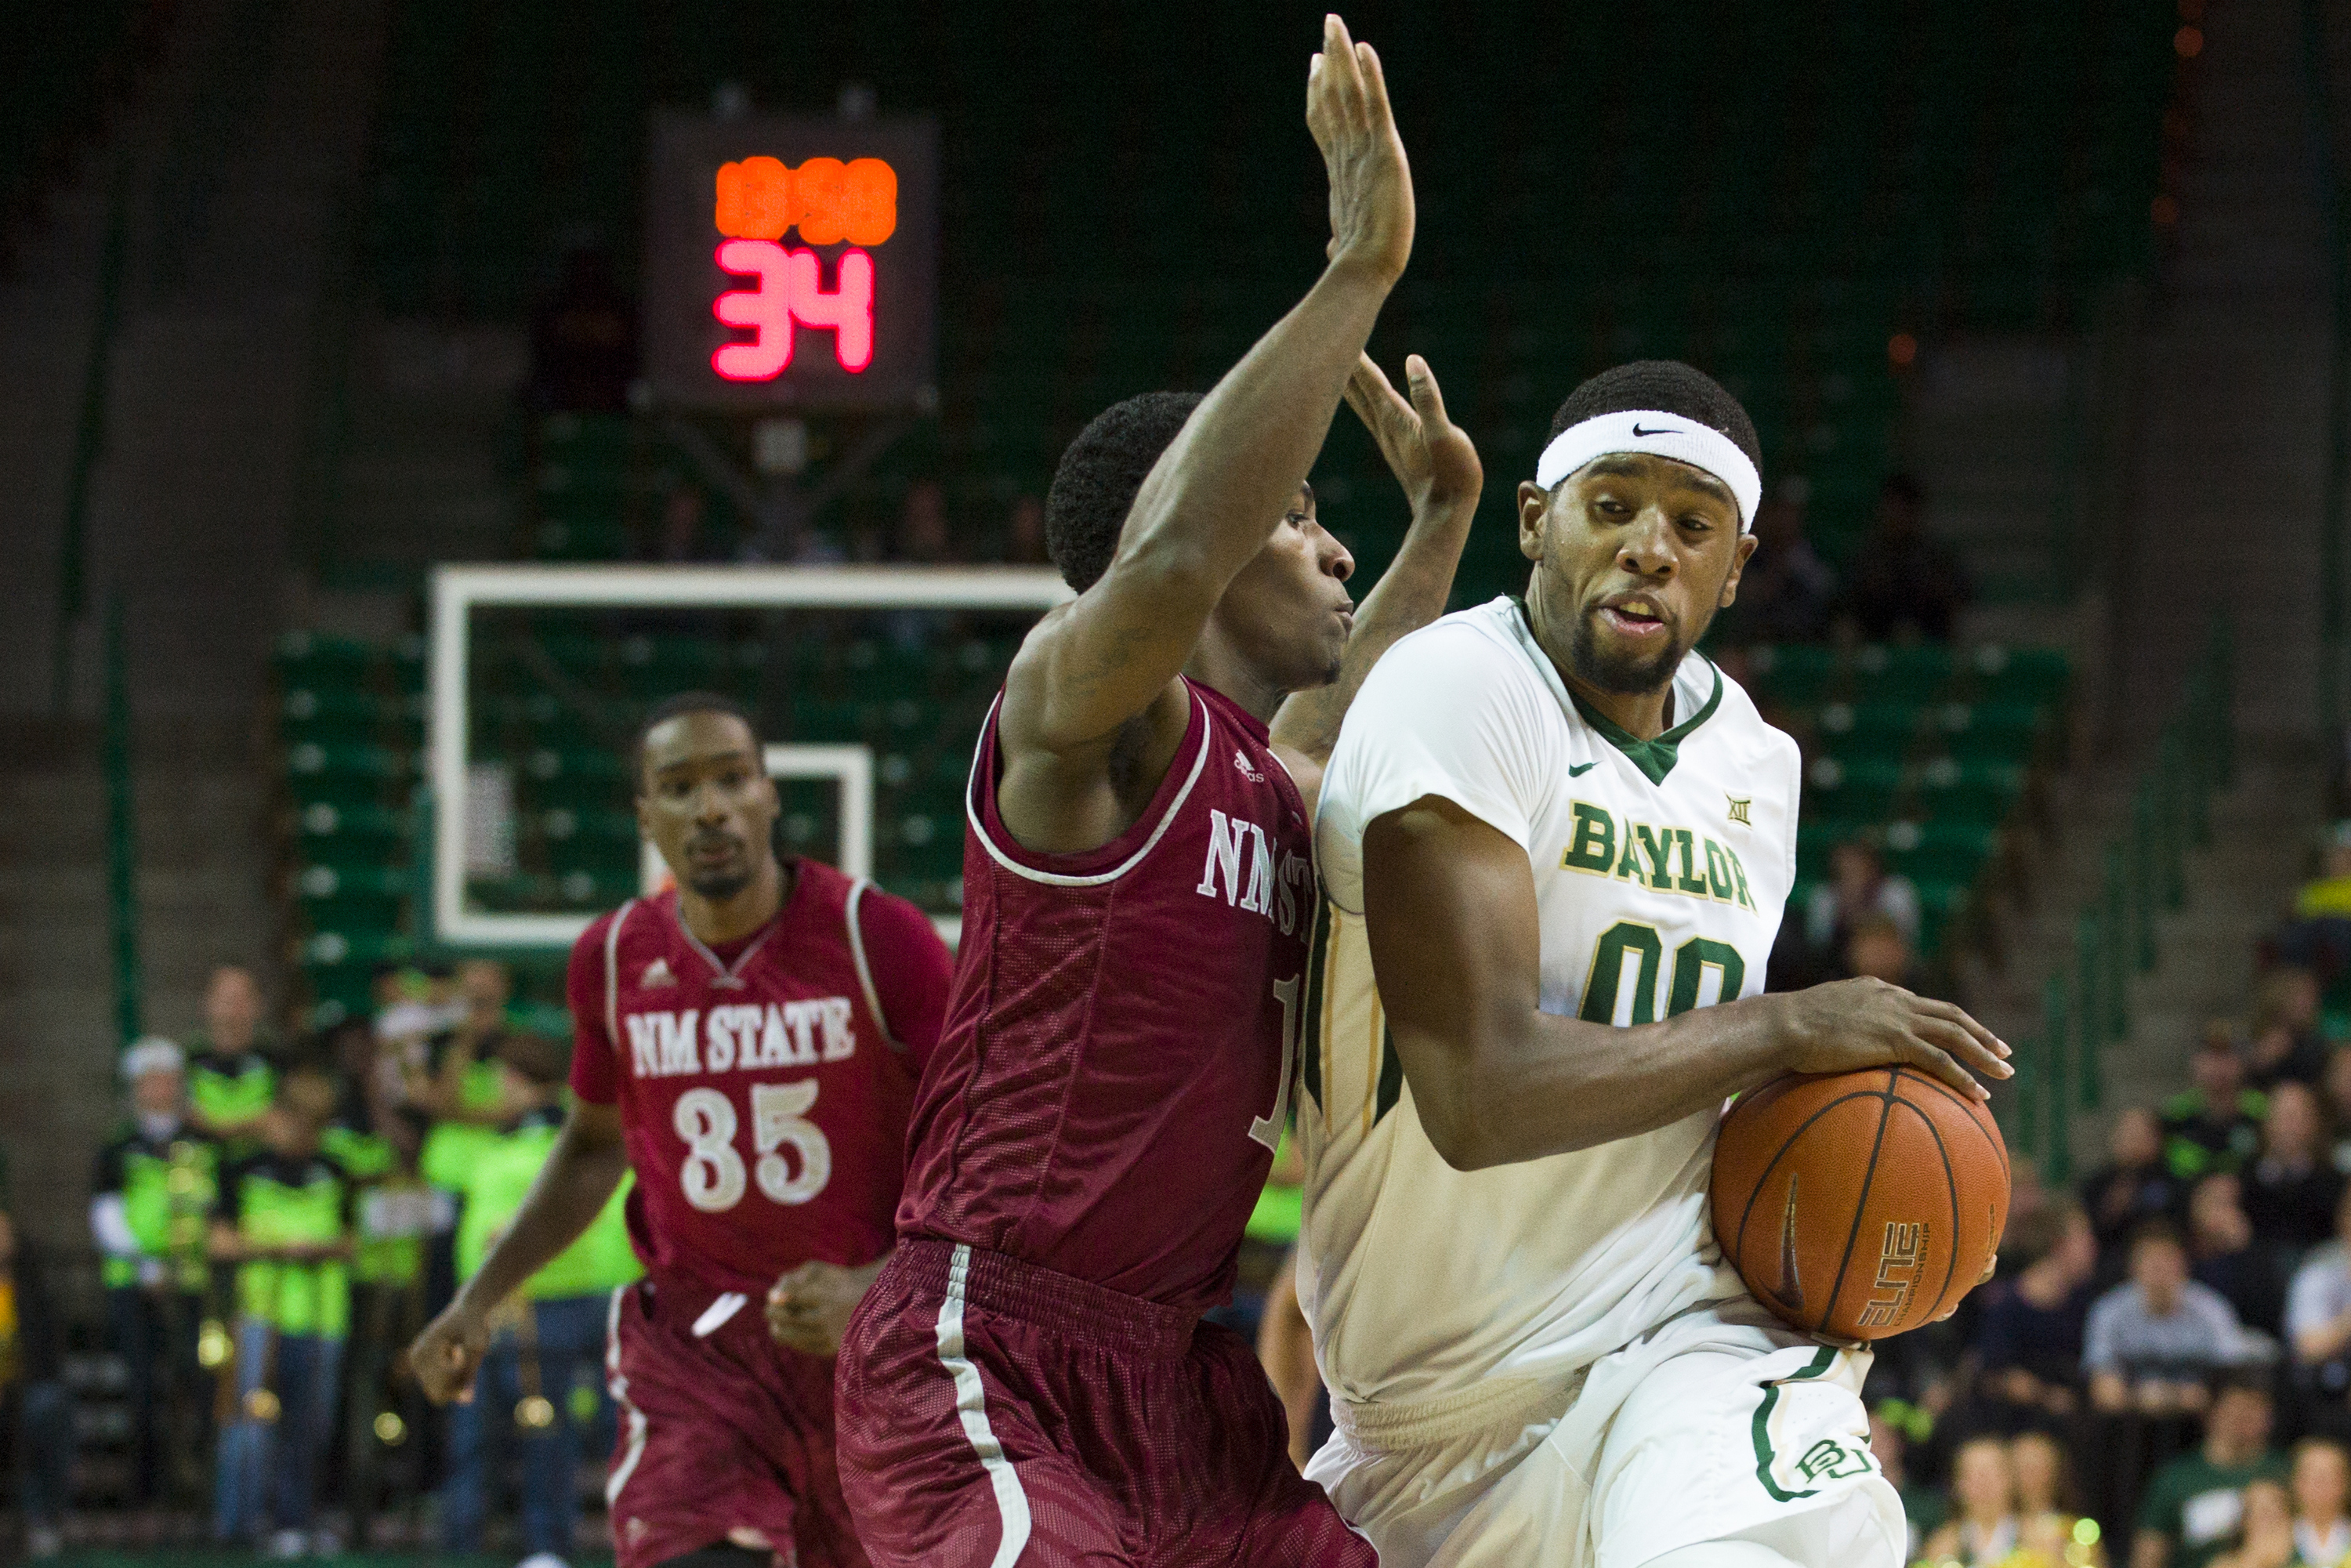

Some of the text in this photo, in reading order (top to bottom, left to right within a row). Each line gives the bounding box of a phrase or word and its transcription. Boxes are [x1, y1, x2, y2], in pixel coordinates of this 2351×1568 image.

[711, 238, 875, 382] 34
[1196, 808, 1276, 925] NM
[1559, 798, 1759, 918] BAYLOR
[1577, 918, 1746, 1027] 00
[627, 996, 856, 1078] NM STATE
[673, 1078, 831, 1214] 85
[1857, 1222, 1920, 1327] ELITE
